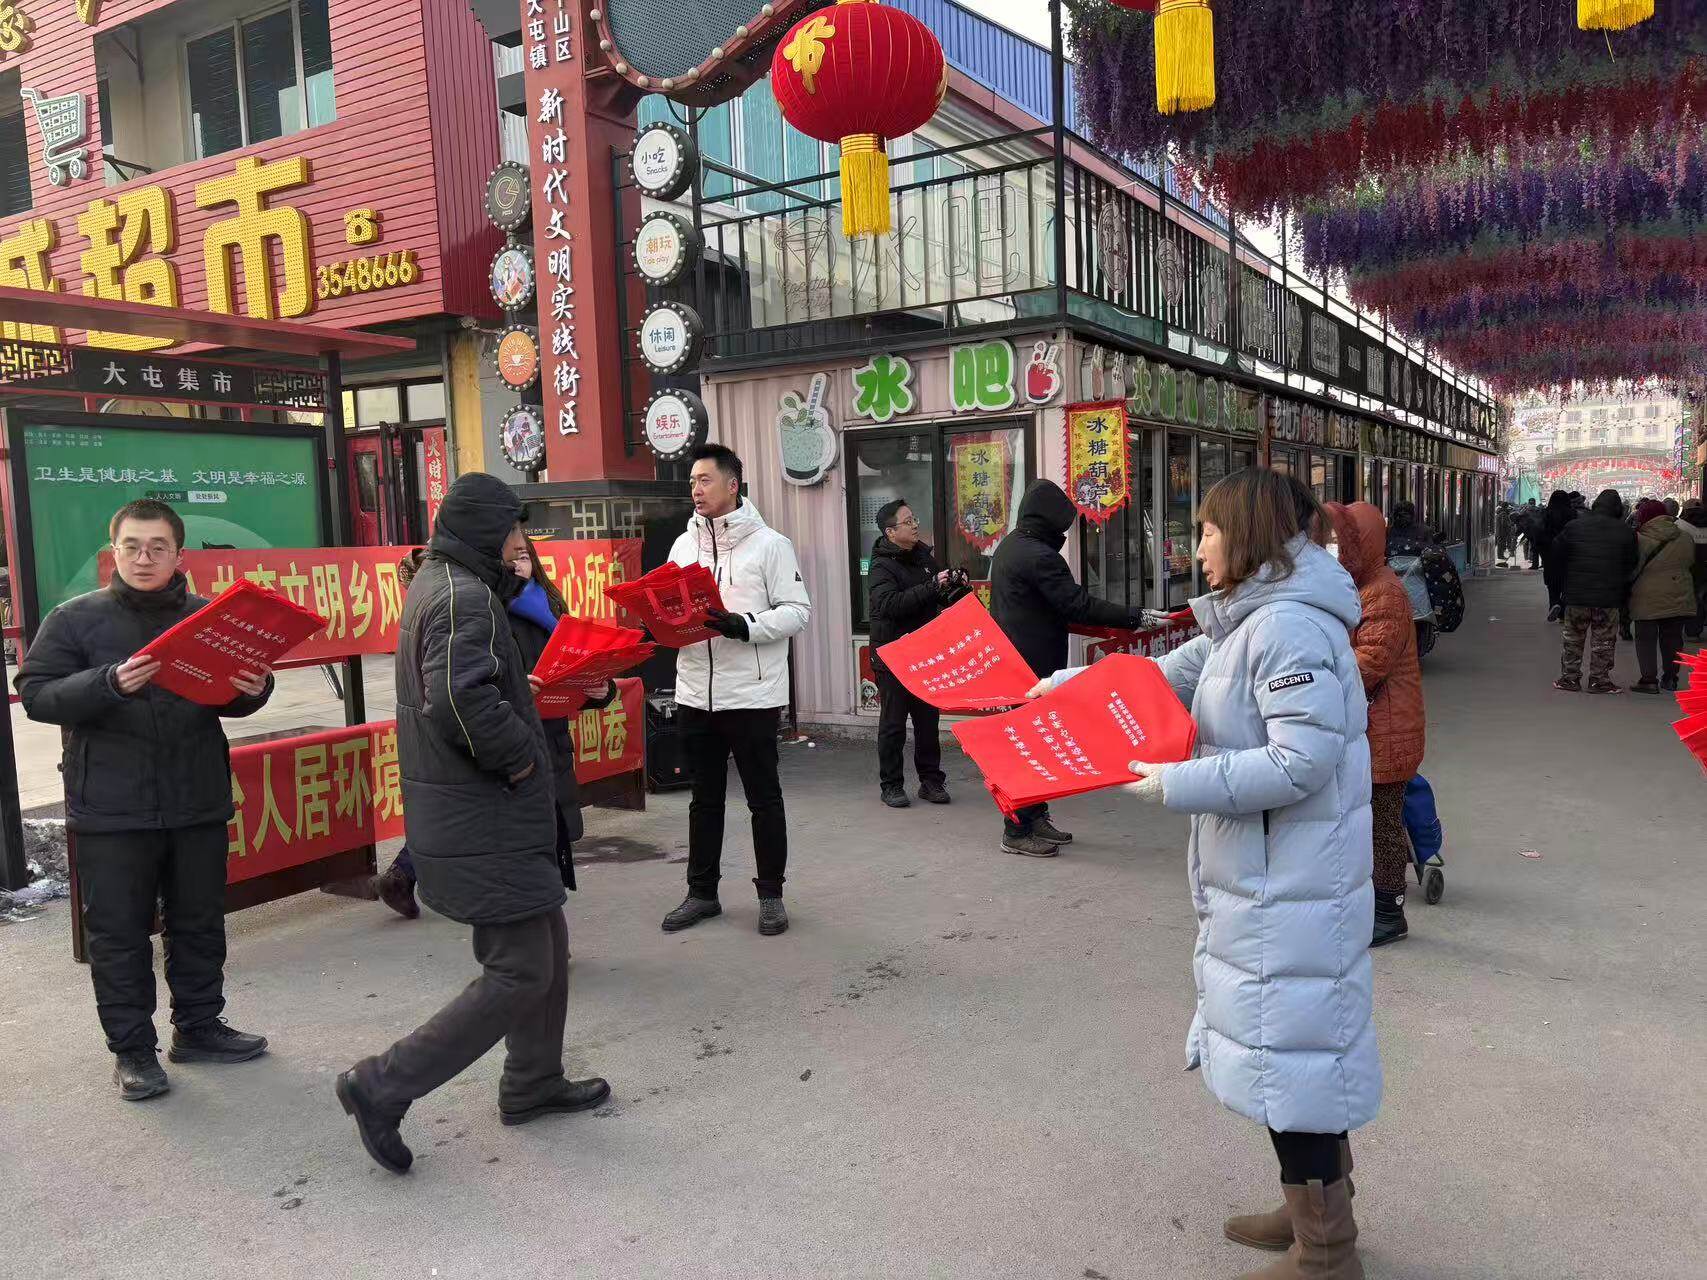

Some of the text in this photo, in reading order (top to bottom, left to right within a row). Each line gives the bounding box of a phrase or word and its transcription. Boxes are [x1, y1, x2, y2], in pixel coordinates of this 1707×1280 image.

[527, 0, 549, 69] 大屯镇
[553, 0, 573, 62] 山区
[641, 147, 666, 164] 小吃
[646, 165, 668, 175] Snacks
[317, 250, 418, 299] 3548666
[537, 88, 581, 436] 新时代文明实践街区
[649, 327, 675, 344] 休闲
[103, 361, 233, 394] 大屯集市
[851, 339, 1016, 422] 水吧
[656, 414, 680, 430] 娱乐
[34, 466, 307, 487] 卫生是健康之基 文明是幸福之源
[1087, 416, 1110, 501] 冰糖葫芦
[971, 449, 991, 533] 冰糖葫芦
[1269, 674, 1312, 690] DESCENTE
[569, 689, 628, 768] 画卷
